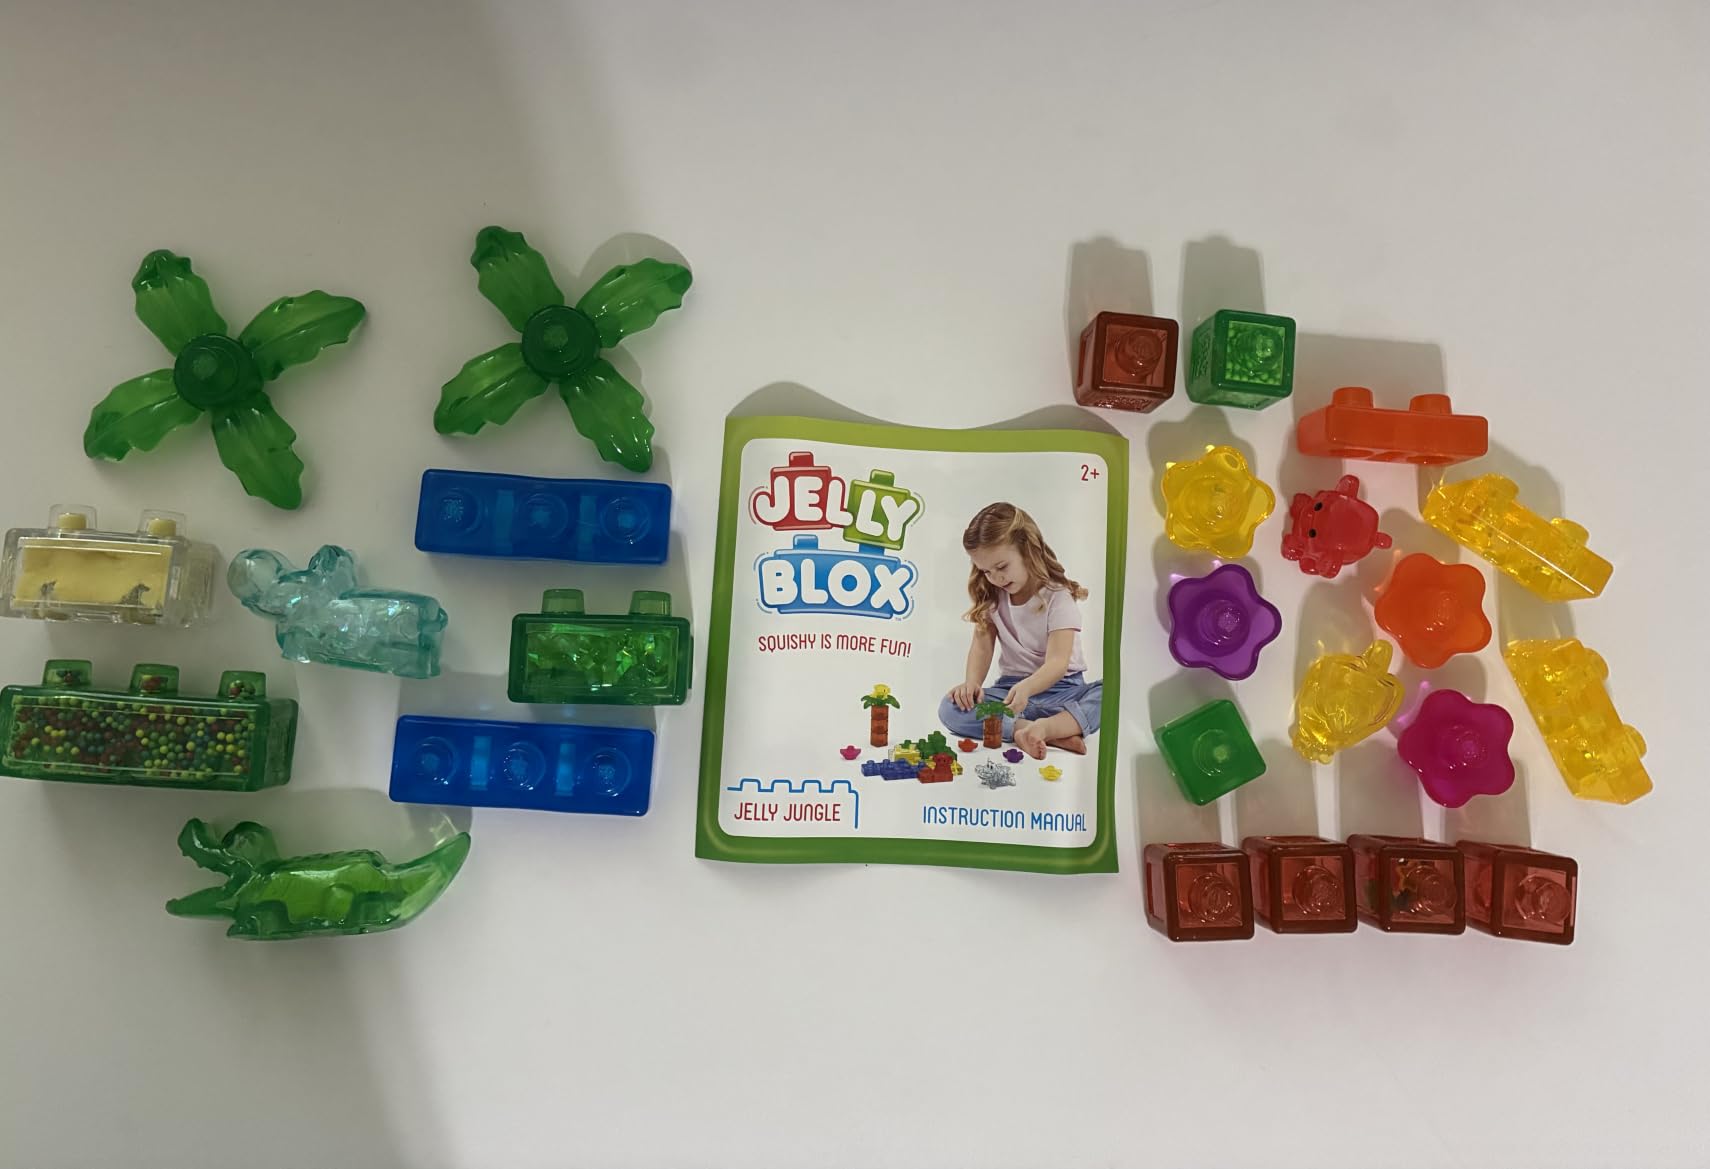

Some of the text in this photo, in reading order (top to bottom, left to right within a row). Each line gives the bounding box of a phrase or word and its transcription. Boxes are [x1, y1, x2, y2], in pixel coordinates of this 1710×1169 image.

[1081, 464, 1100, 481] 2+
[755, 475, 918, 541] JELLY
[761, 558, 911, 612] BLOX
[758, 633, 912, 658] SQUISHY IS MORE FUN!
[734, 802, 841, 822] JELLY JUNGLE
[923, 805, 1087, 832] INSTRUCTION MANUAL
